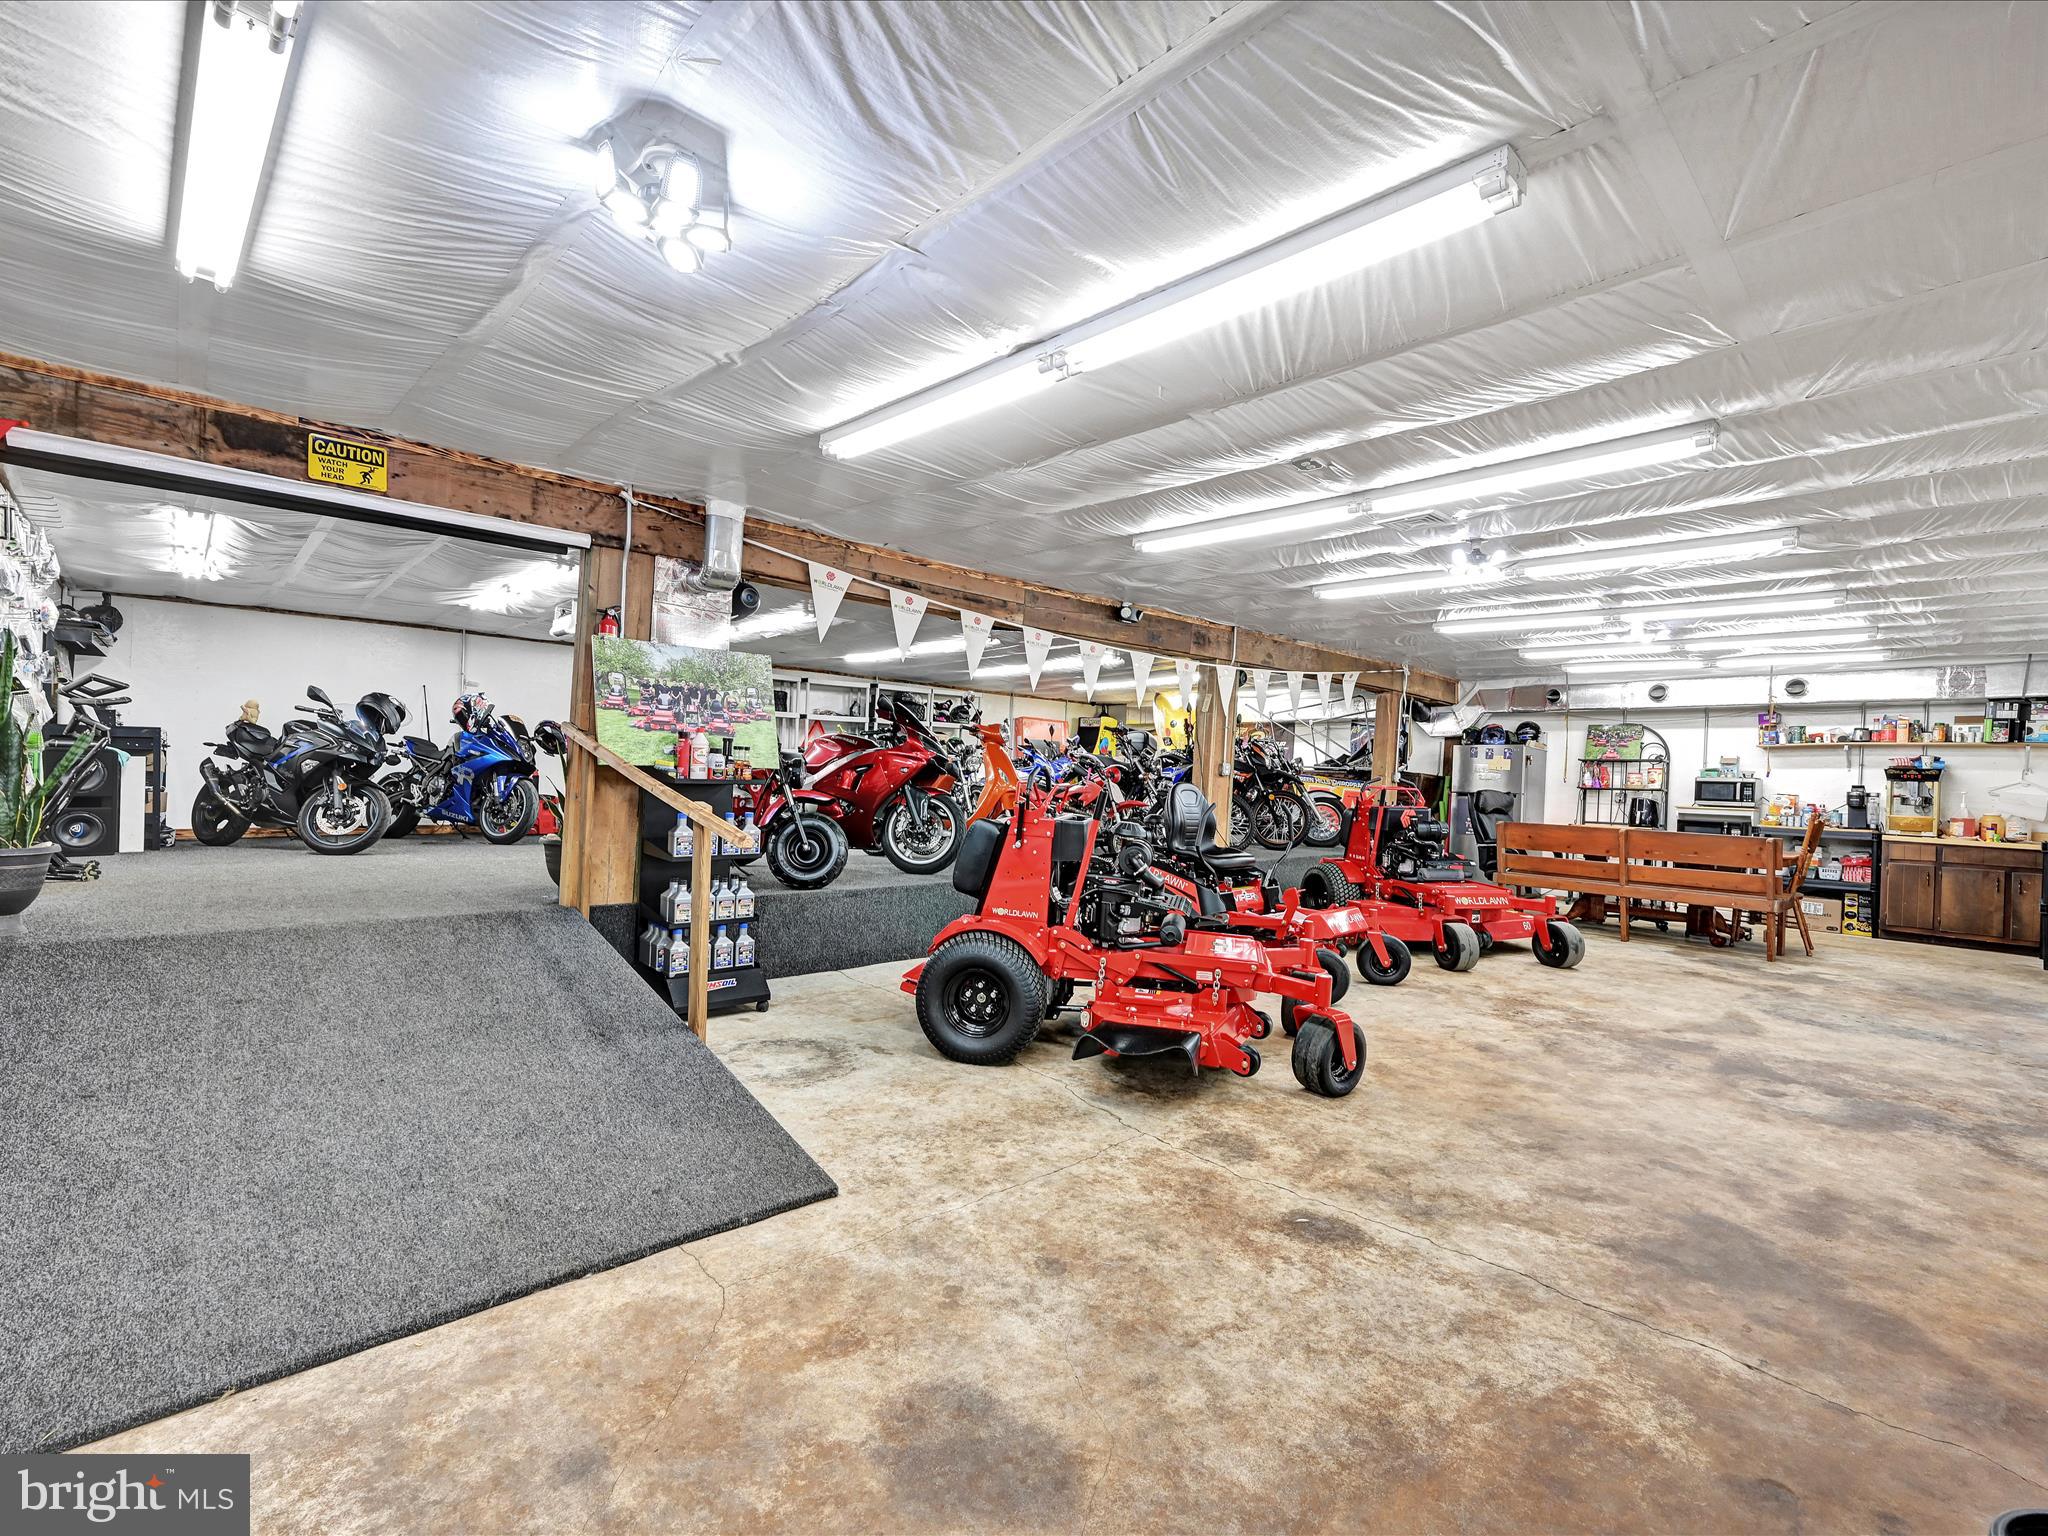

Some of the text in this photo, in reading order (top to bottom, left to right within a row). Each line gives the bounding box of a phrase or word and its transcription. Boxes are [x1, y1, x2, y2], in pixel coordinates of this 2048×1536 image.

[314, 440, 383, 465] CAUTION
[318, 457, 348, 468] WATCH
[321, 465, 345, 474] YOUR
[321, 472, 345, 481] HEAD
[441, 809, 469, 822] SUZUKI
[1233, 891, 1259, 903] VIPER
[1455, 896, 1509, 905] WORLDLAWN
[992, 907, 1039, 919] WORLDLAWN
[1522, 921, 1532, 931] 60
